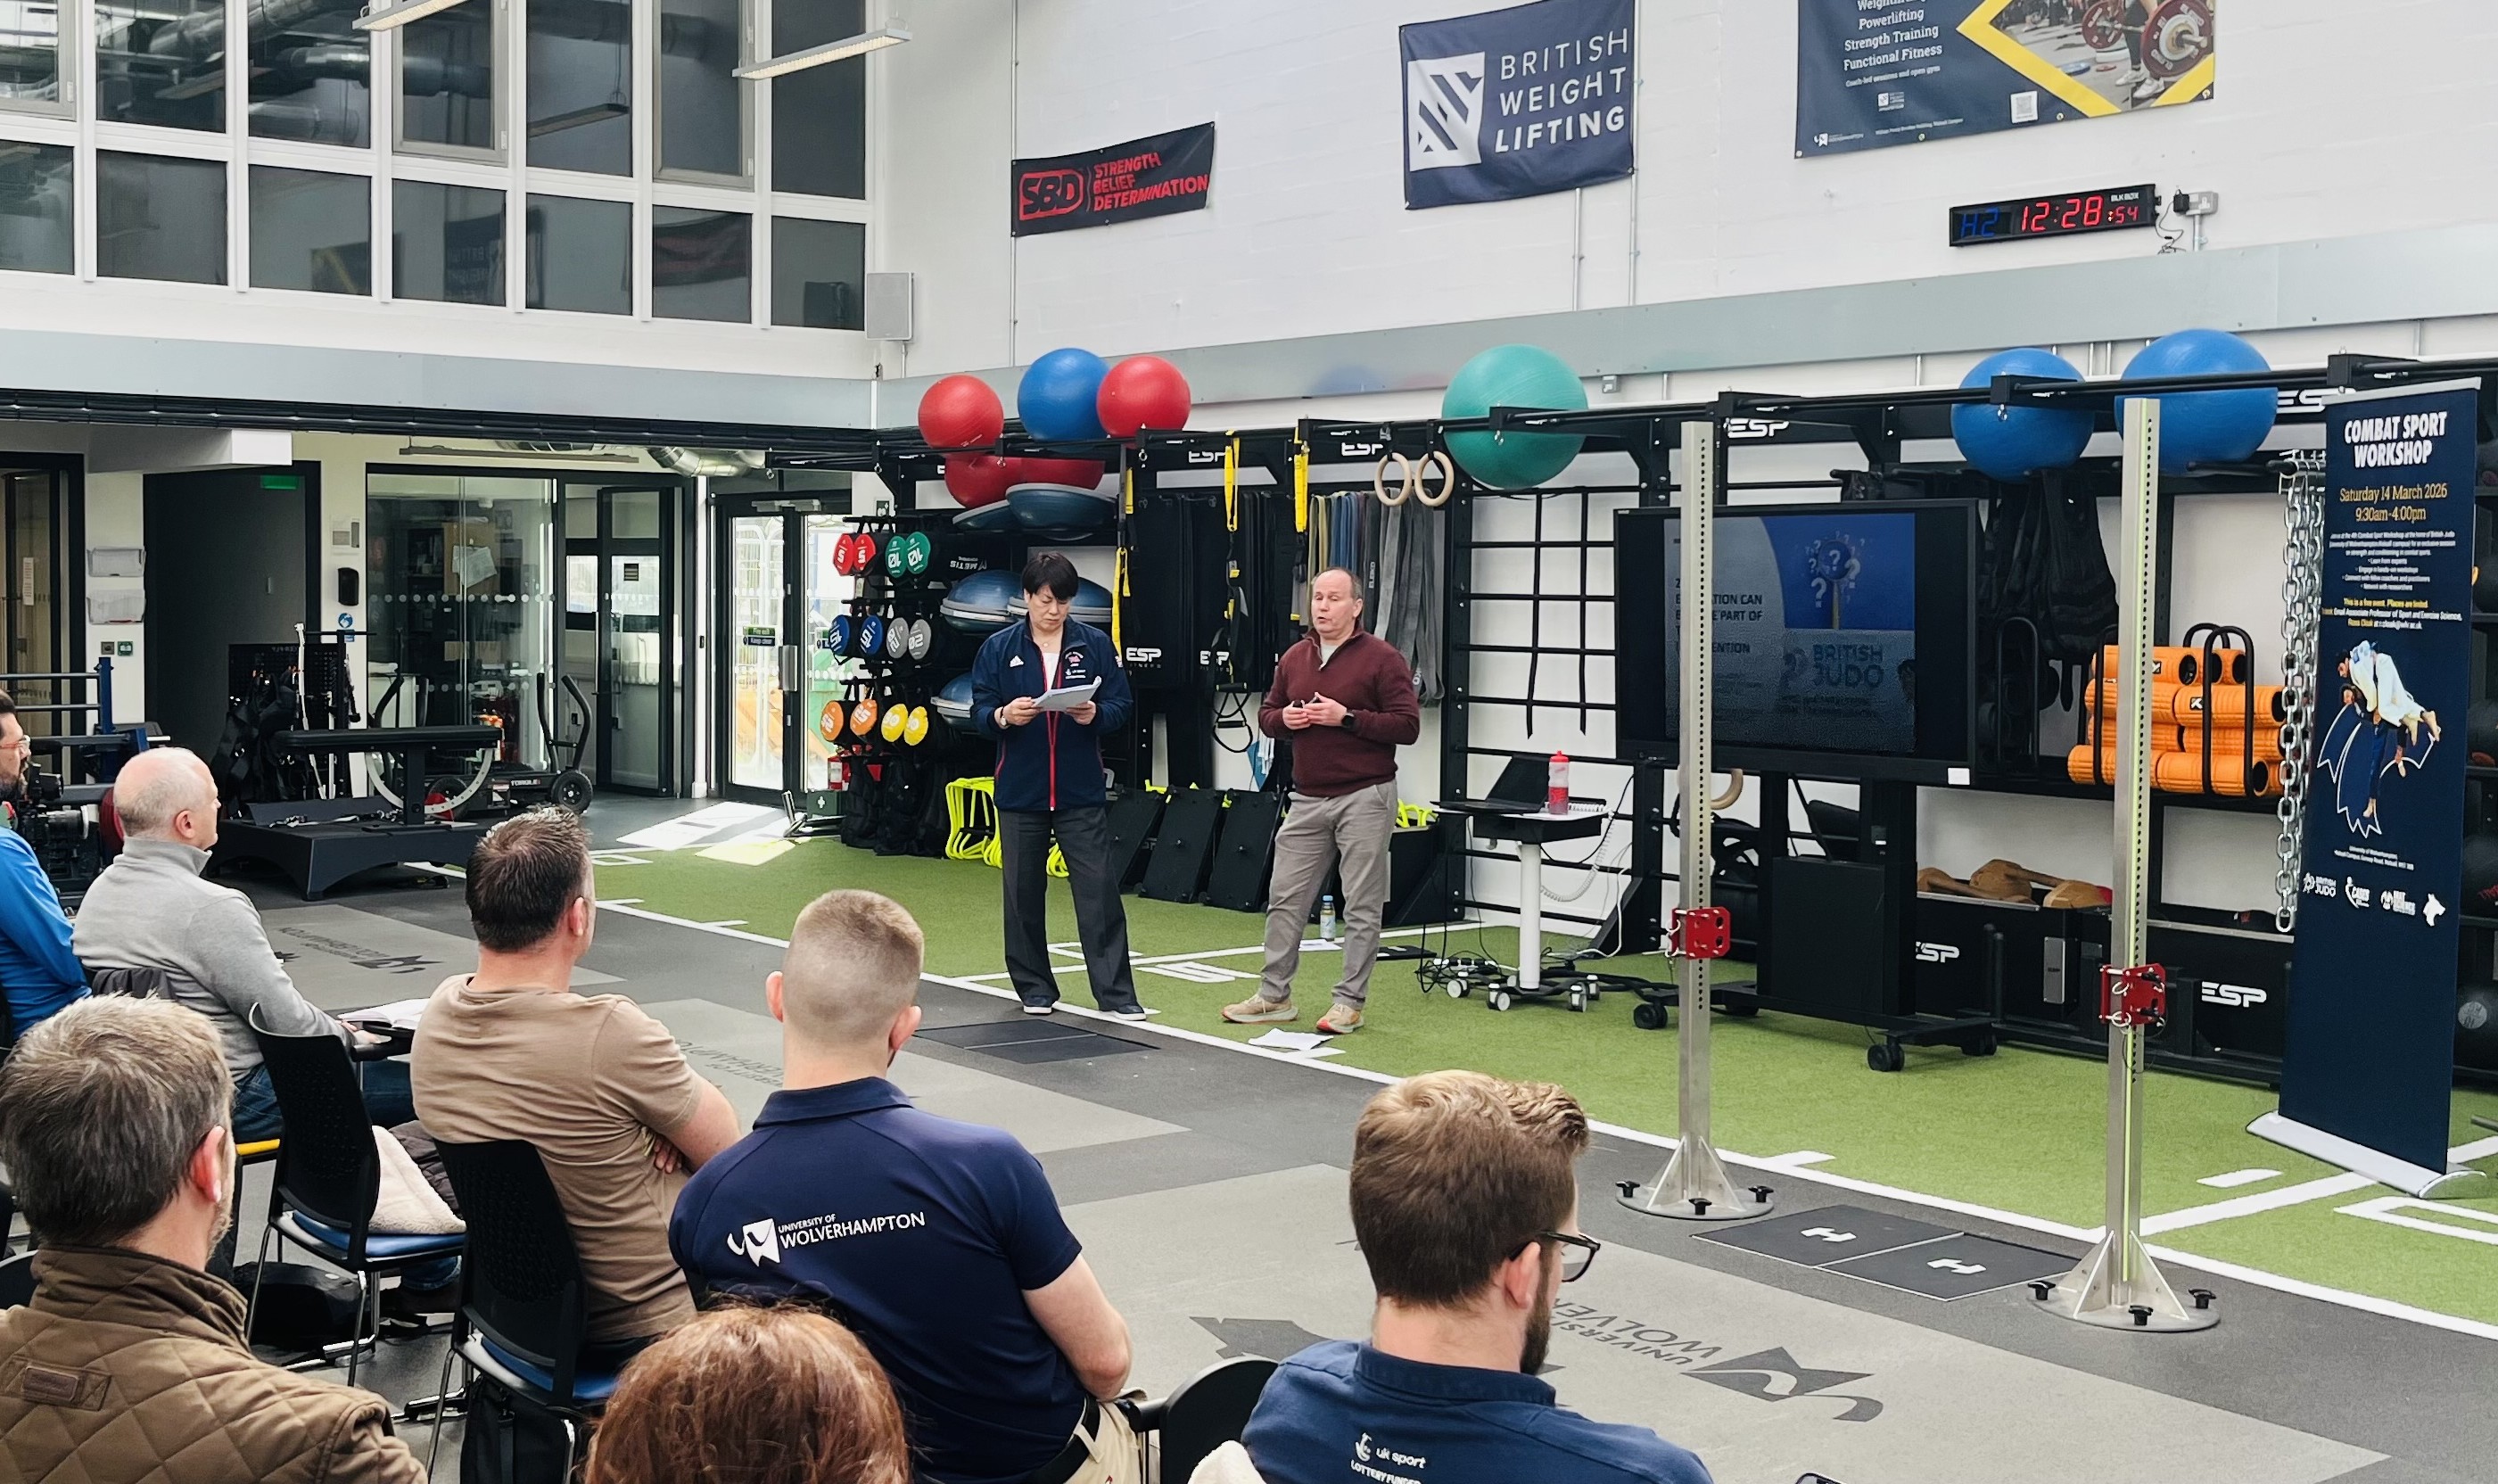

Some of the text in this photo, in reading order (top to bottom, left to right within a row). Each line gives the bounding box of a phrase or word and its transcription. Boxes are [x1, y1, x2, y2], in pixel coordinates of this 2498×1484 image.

[1858, 8, 1925, 30] Powerlifting
[1844, 25, 1939, 52] Strength Training
[1501, 28, 1628, 80] BRITISH
[1843, 45, 1942, 70] Functional Fitness
[1499, 66, 1627, 116] WEIGHT
[1495, 105, 1624, 153] LIFTING
[1093, 152, 1162, 178] STRENGTH
[1021, 172, 1081, 217] SBD
[1092, 173, 1135, 194] BELIEF
[1093, 174, 1210, 211] DETERMINATION
[2275, 387, 2356, 414] ES
[2344, 410, 2447, 444] COMBAT SPORT
[2354, 439, 2433, 468] WORKSHOP
[2339, 482, 2447, 505] Saturday 14 March 2026
[837, 549, 845, 564] 5
[858, 549, 866, 563] 5
[1741, 594, 1762, 605] CAN
[1720, 610, 1746, 621] PART
[1748, 610, 1763, 621] OF
[1125, 647, 1162, 662] ESP
[1200, 650, 1230, 665] EP
[1812, 643, 1884, 663] BRITISH
[2201, 981, 2267, 1008] ESP
[778, 1213, 837, 1233] UNIVERSITY OF
[779, 1211, 926, 1249] WOLVERHAMPTON
[1375, 1447, 1426, 1469] uk sport
[1350, 1459, 1387, 1482] LOTTERY
